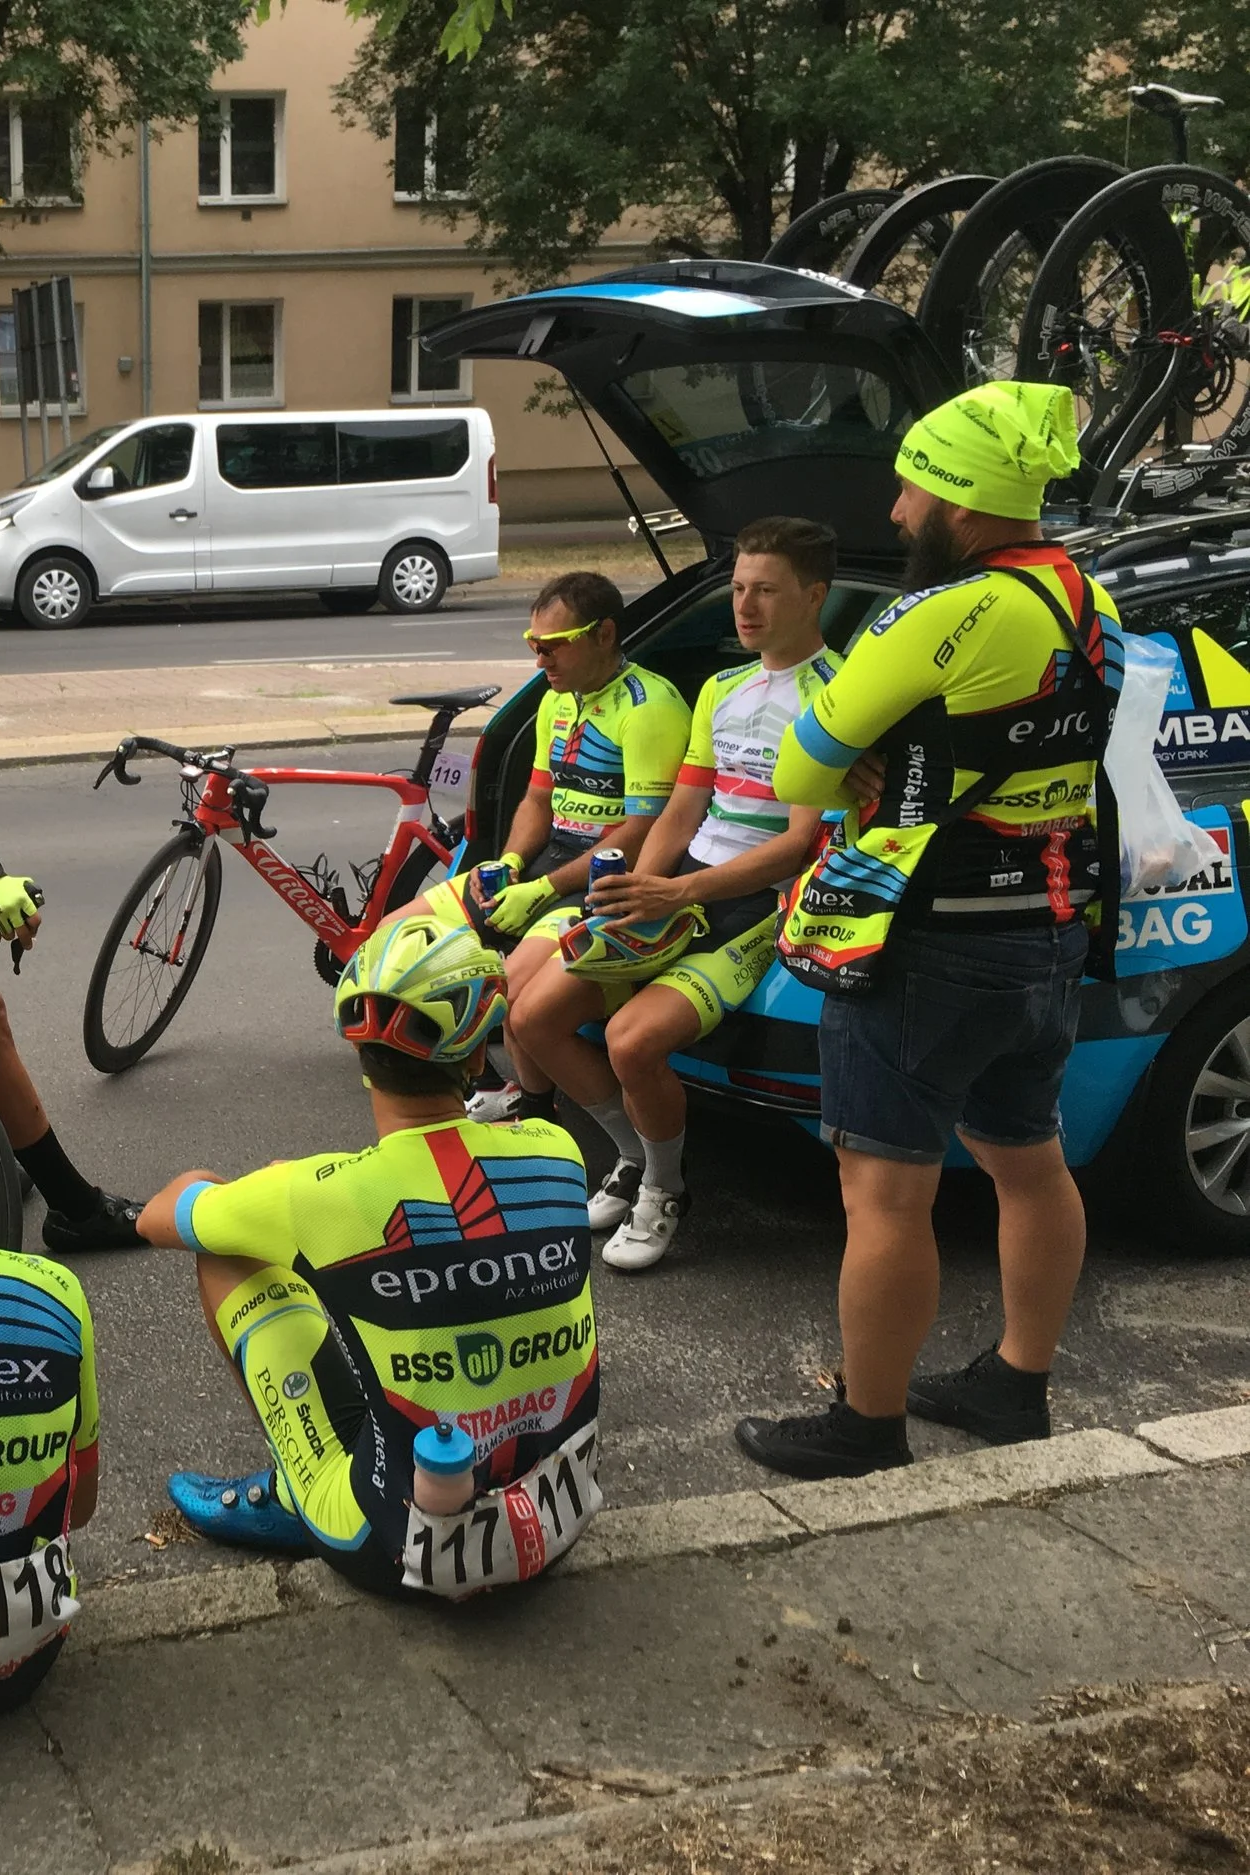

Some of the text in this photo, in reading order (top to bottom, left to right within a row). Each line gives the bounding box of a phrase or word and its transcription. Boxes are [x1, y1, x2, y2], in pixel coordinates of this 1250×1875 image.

[928, 465, 975, 489] GROUP
[953, 591, 1000, 644] FORCE
[1178, 750, 1209, 760] DRINK
[434, 766, 462, 786] 119
[562, 799, 626, 817] GROU
[253, 842, 342, 937] Wilier
[803, 925, 856, 944] GROUP
[461, 964, 497, 979] FORCE
[691, 981, 715, 1013] GROUP
[370, 1236, 578, 1303] epronex
[287, 1282, 310, 1296] BSS
[504, 1285, 526, 1301] Az
[230, 1293, 267, 1330] GROUP
[390, 1350, 455, 1384] BSS
[508, 1313, 594, 1369] GROUP
[258, 1367, 316, 1487] PORSCHE
[296, 1402, 326, 1462] ŠKODA
[456, 1387, 557, 1441] STRABAG
[538, 1432, 597, 1539] 117
[412, 1507, 499, 1586] 117
